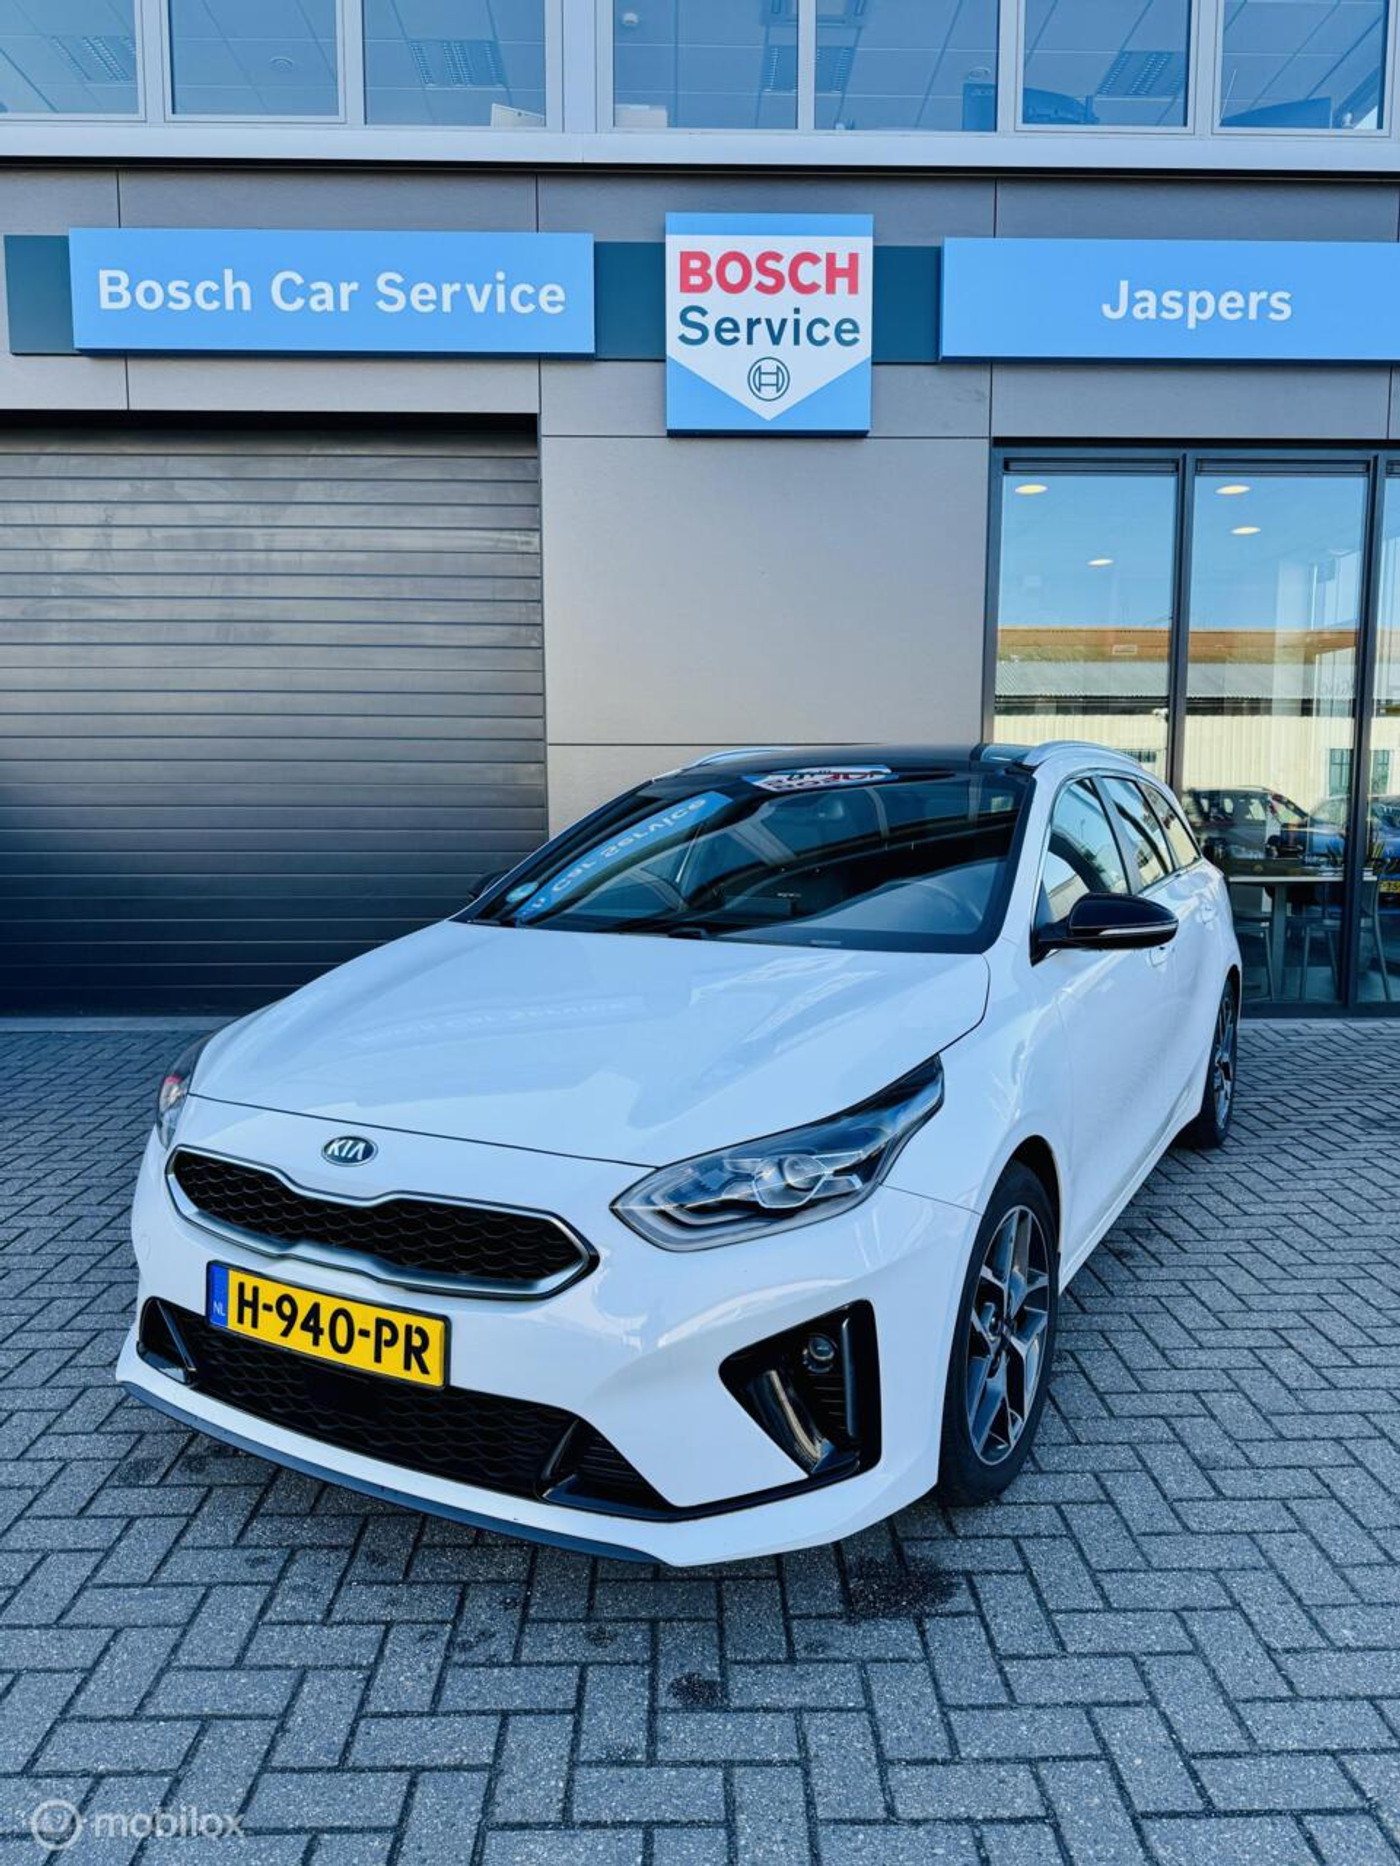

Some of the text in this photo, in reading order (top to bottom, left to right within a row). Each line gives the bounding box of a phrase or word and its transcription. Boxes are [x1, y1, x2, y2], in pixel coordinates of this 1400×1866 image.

[98, 268, 566, 315] Bosch Car Service
[679, 250, 859, 296] BOSCH
[678, 304, 860, 347] Service
[1101, 280, 1293, 329] Jaspers
[326, 1139, 365, 1161] KIA
[212, 1300, 226, 1317] NL
[236, 1281, 431, 1375] H-940-PR
